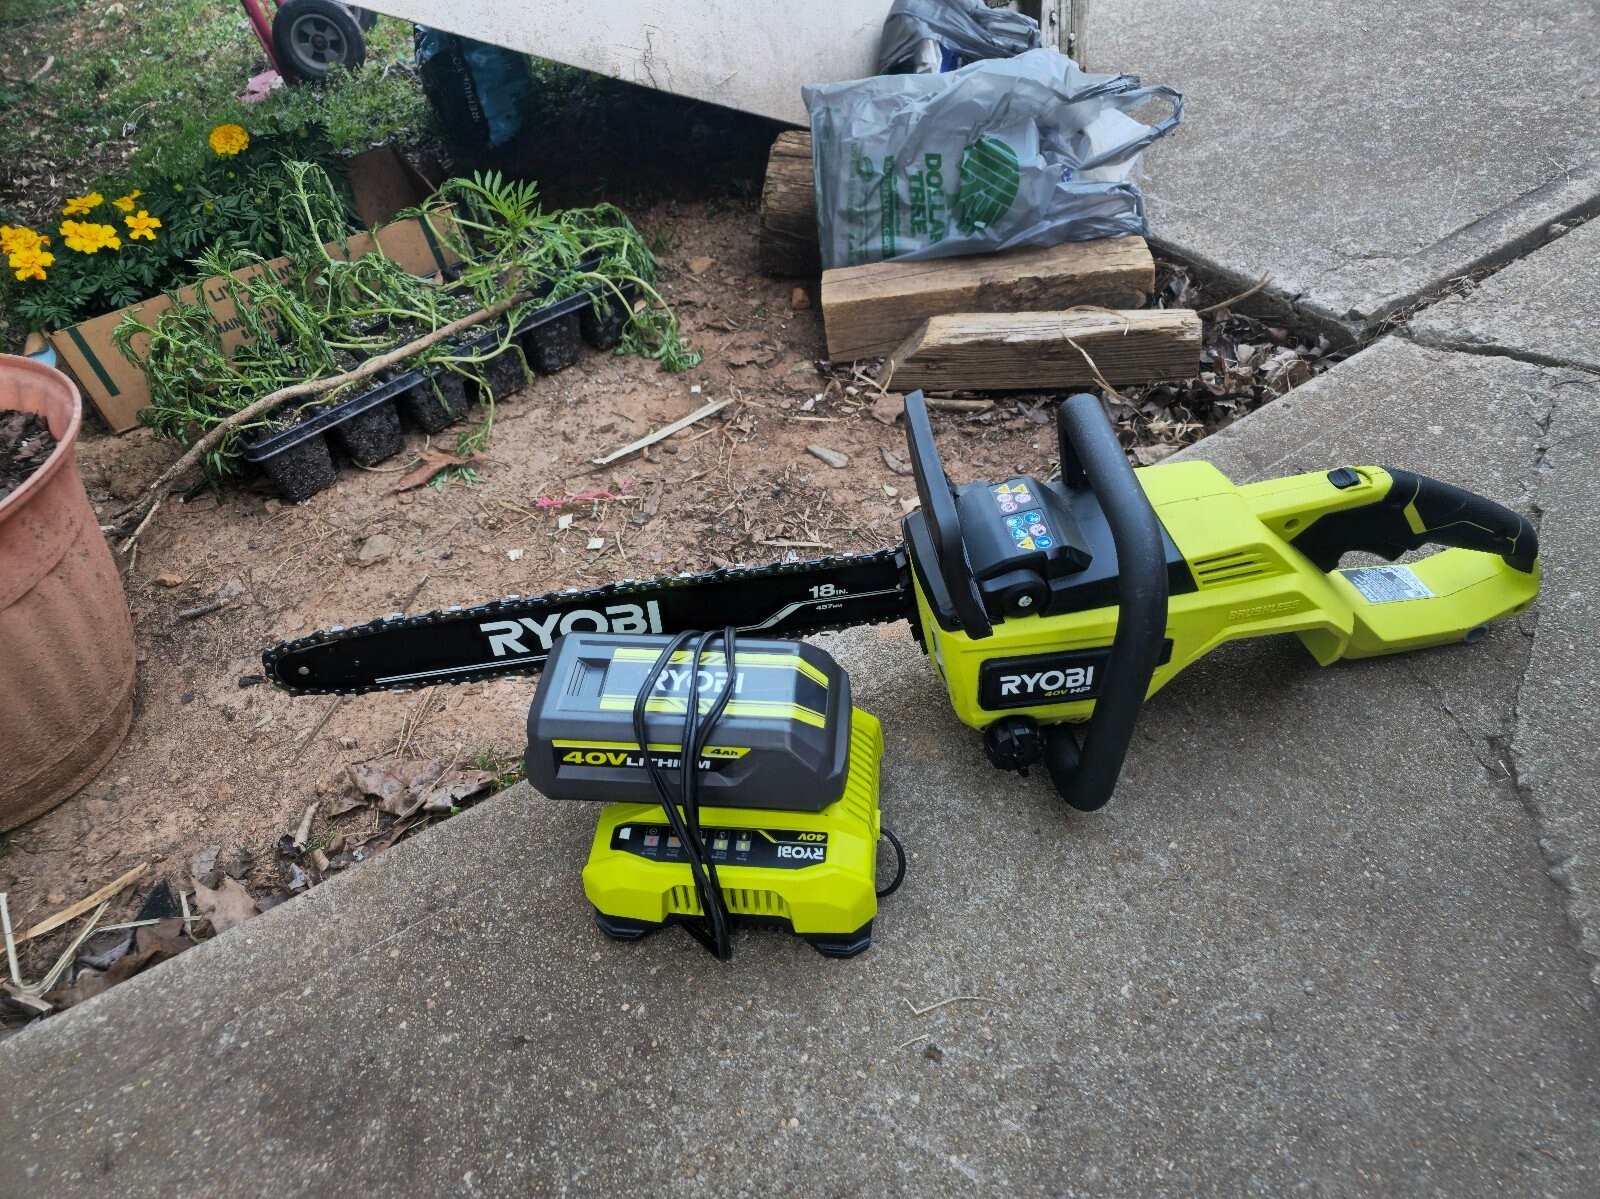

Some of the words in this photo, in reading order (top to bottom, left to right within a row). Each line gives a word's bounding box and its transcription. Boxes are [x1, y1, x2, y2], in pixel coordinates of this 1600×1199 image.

[909, 170, 928, 238] TREE
[1228, 599, 1300, 620] BRUSHLESS
[480, 600, 664, 656] RYOBI
[1000, 666, 1094, 695] RYOBI
[1070, 686, 1091, 694] HP
[626, 757, 711, 770] LIHIM
[798, 833, 826, 842] 40V
[778, 845, 824, 859] RYOBI
